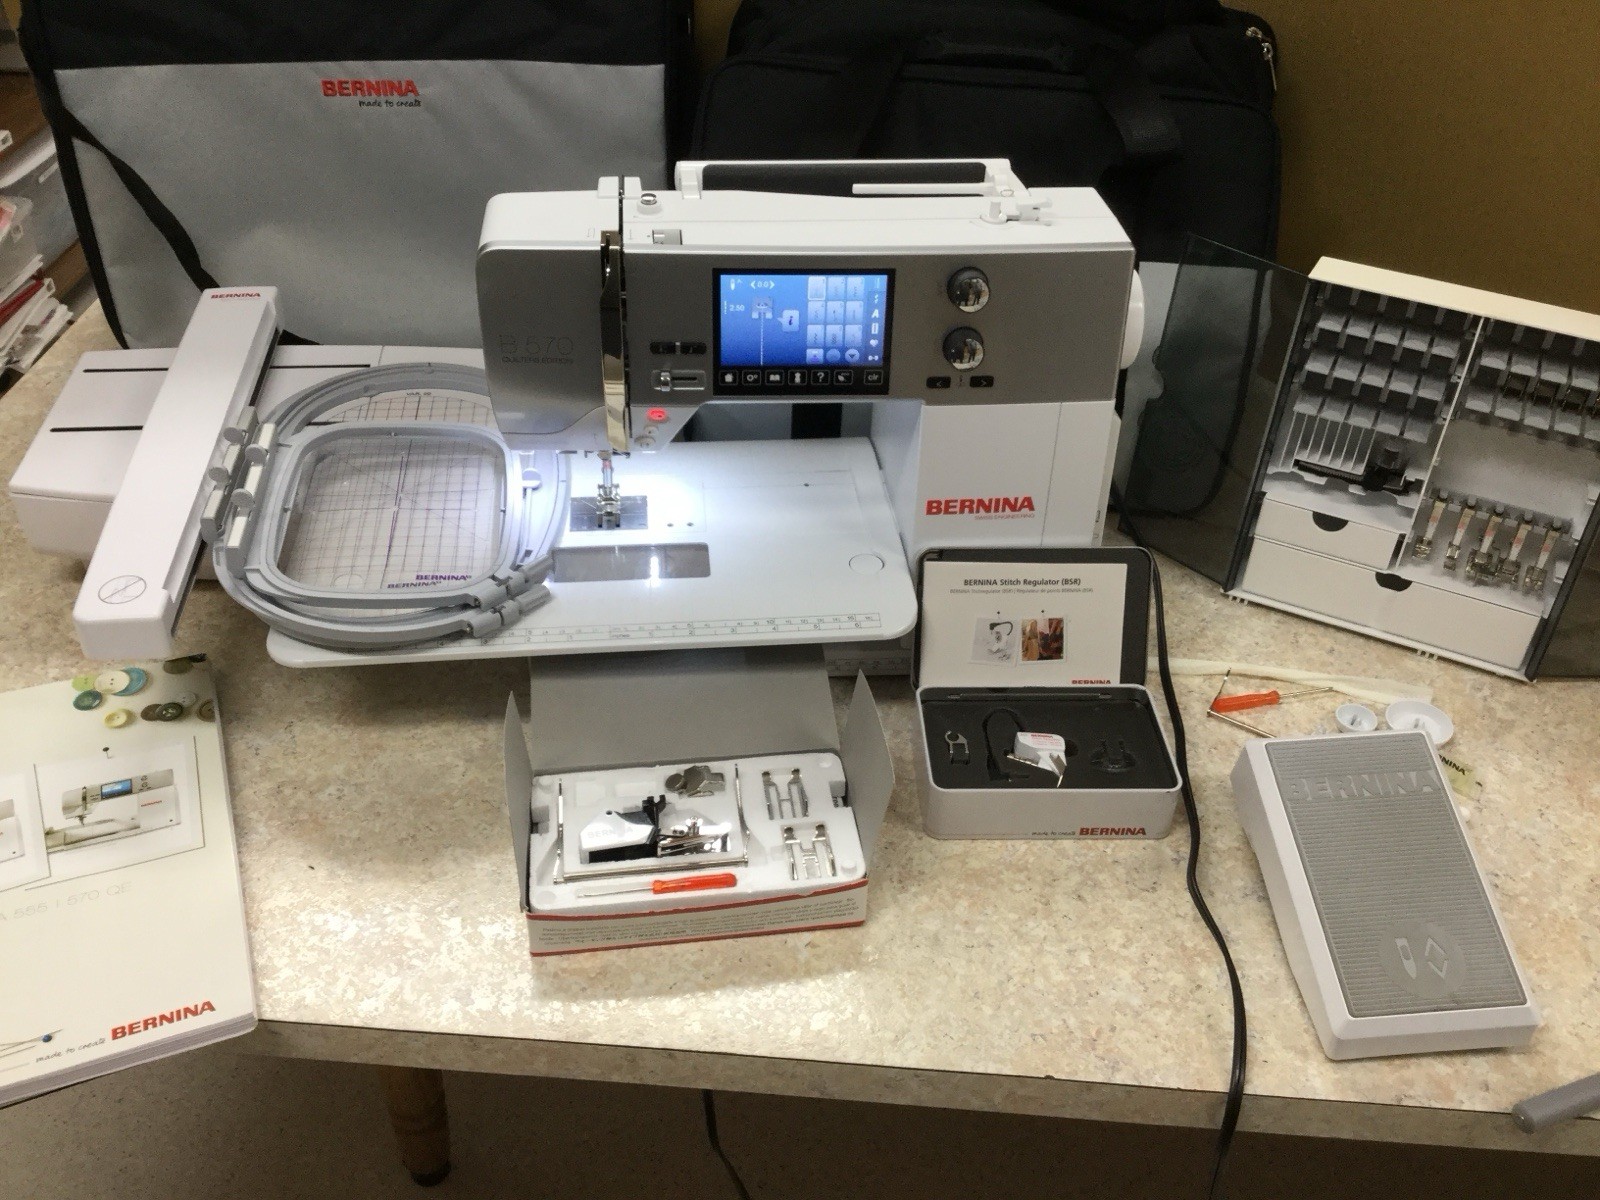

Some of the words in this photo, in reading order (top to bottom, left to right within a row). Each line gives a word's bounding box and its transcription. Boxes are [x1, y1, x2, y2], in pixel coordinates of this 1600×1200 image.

[322, 79, 419, 97] BERNINA
[385, 99, 394, 107] to
[526, 335, 574, 355] 570
[925, 496, 1035, 516] BERNINA
[963, 578, 998, 586] BERNINA
[1000, 578, 1021, 586] Stitch
[1023, 578, 1060, 587] Regulator
[1061, 578, 1081, 586] (BSR)
[1286, 771, 1441, 801] BERNINA
[1079, 827, 1147, 836] BERNINA
[67, 890, 100, 906] 570
[107, 881, 132, 896] QE
[35, 1051, 62, 1064] made
[65, 1046, 76, 1054] to
[110, 1000, 216, 1041] BERNINA
